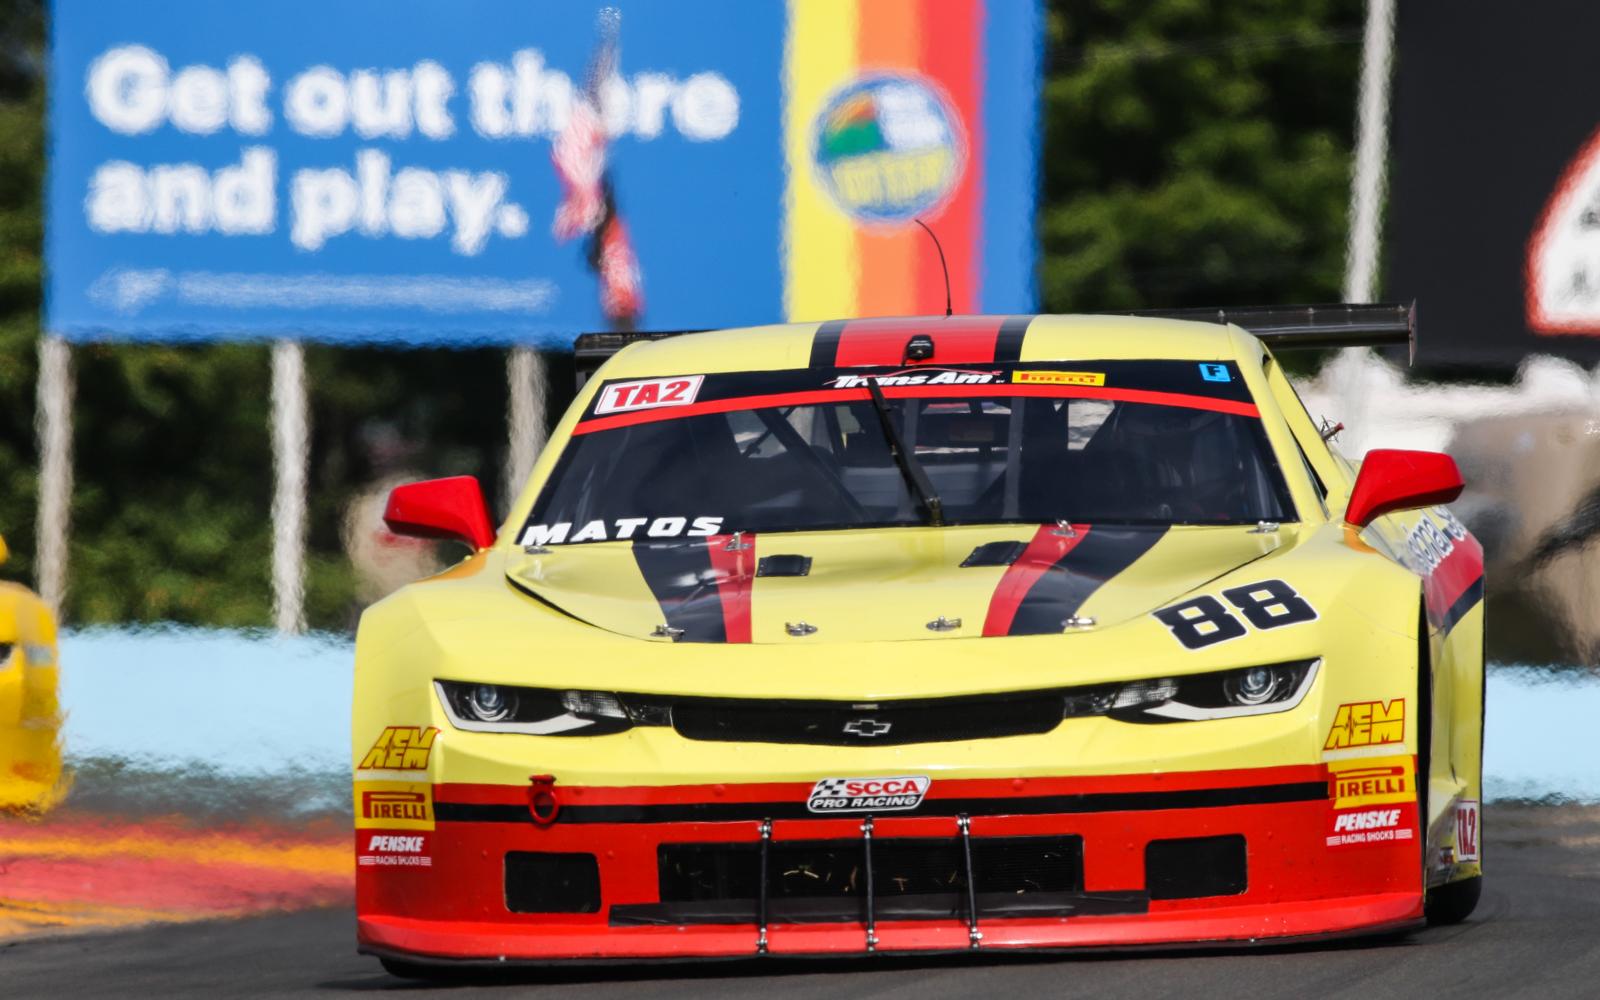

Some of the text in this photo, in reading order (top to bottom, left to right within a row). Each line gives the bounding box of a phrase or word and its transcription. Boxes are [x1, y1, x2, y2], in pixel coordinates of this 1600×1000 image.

[86, 43, 272, 136] Get
[284, 60, 454, 140] out
[86, 145, 530, 256] and play.
[1020, 373, 1097, 384] PIRELLI
[1206, 365, 1221, 378] F
[613, 380, 692, 408] TA2
[520, 517, 724, 546] MATOS
[1152, 579, 1318, 650] 88
[1323, 698, 1405, 750] AEM
[357, 726, 442, 771] AEM
[846, 780, 920, 796] SCCA
[1329, 766, 1405, 799] PIRELLI
[362, 791, 426, 820] PIRELLI
[812, 795, 918, 808] PRO RACING
[1334, 809, 1401, 832] PENSKE
[369, 835, 425, 852] PENSKE
[1341, 830, 1394, 844] RACING SHOCKS
